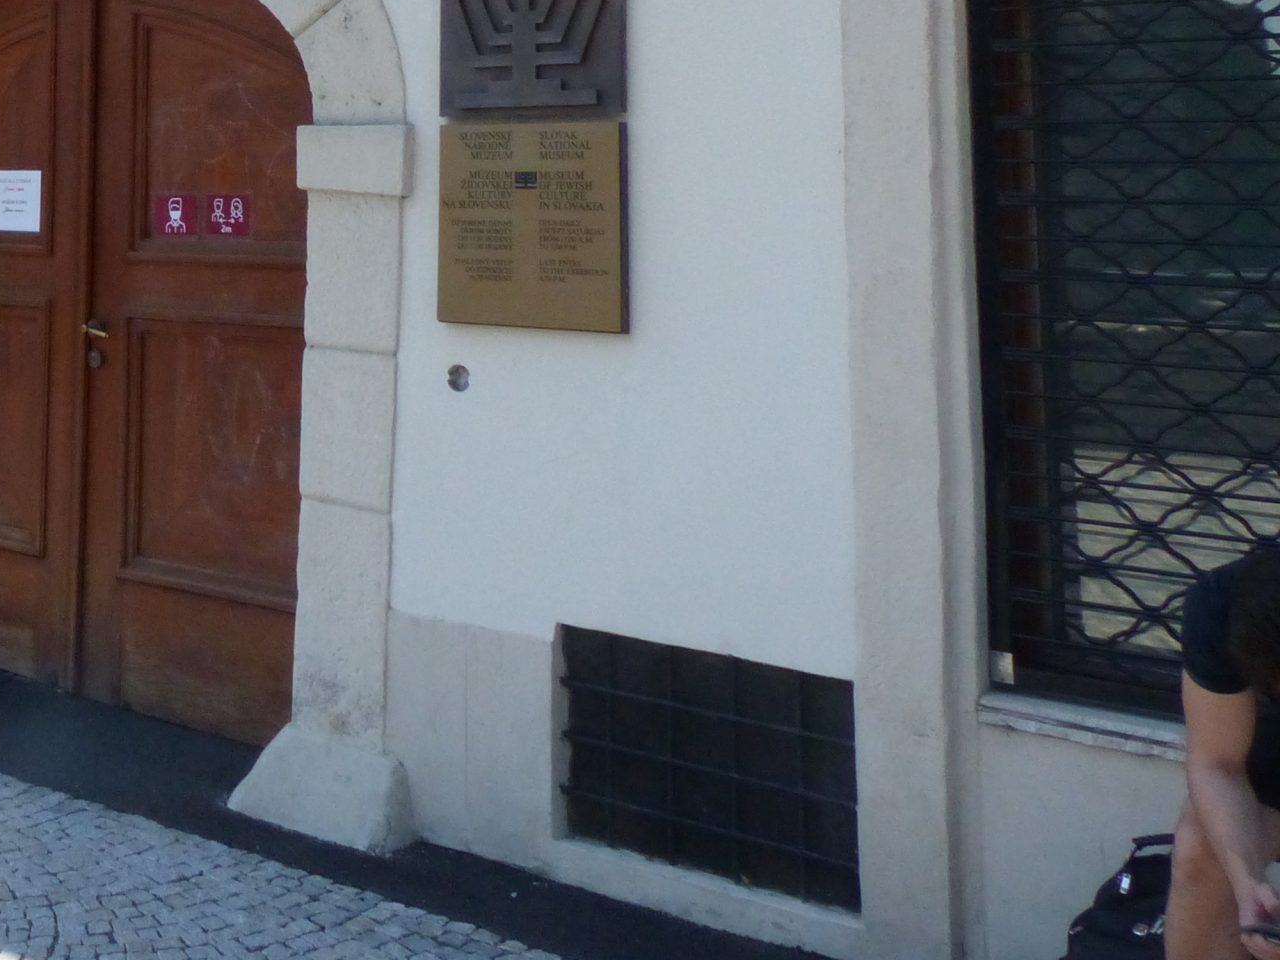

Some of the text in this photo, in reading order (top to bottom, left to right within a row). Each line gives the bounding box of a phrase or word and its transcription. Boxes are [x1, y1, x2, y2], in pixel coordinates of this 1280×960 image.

[539, 130, 578, 140] SLOVAK
[539, 140, 592, 150] NATIONAL
[539, 151, 584, 160] MUSEUM
[539, 170, 585, 180] MUSEUM
[555, 180, 593, 190] JEWISH
[539, 191, 587, 200] CULTURE
[552, 201, 605, 212] SLOVAKIA
[221, 224, 232, 233] 2m
